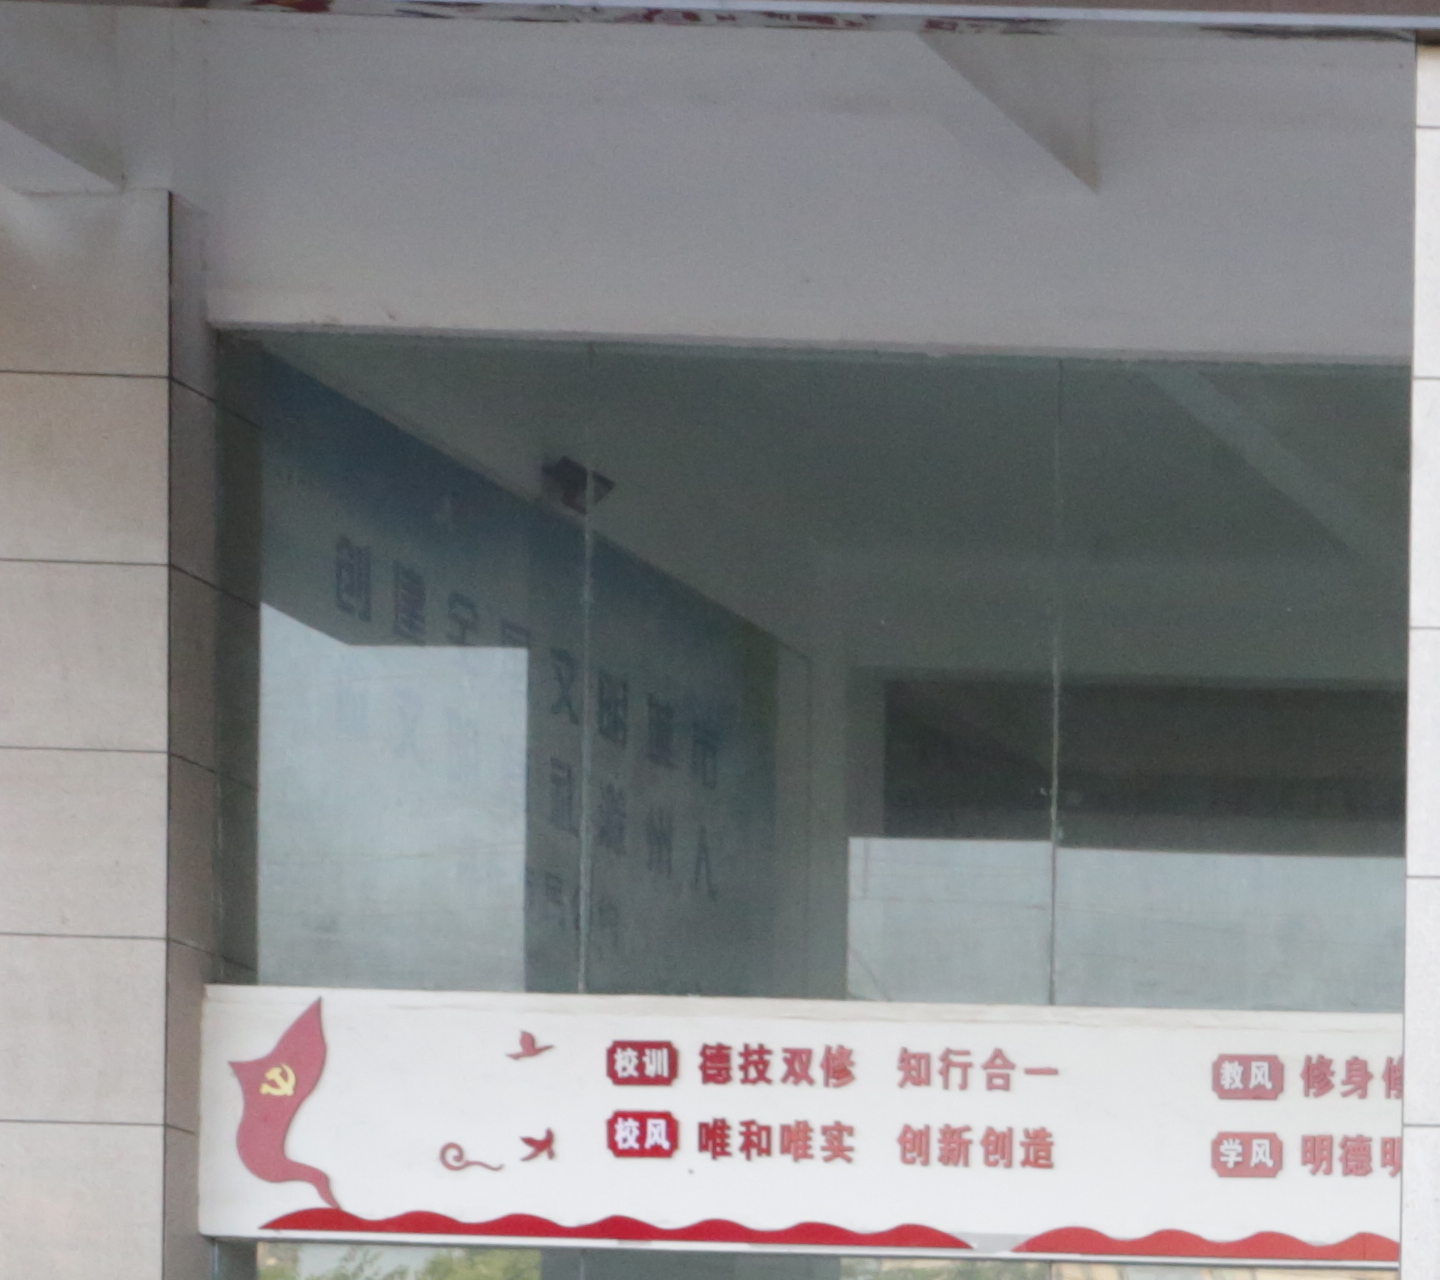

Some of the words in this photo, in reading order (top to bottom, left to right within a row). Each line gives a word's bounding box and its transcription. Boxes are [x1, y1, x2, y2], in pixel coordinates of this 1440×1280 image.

[613, 1047, 669, 1078] 校训
[698, 1043, 856, 1088] 德技双修
[897, 1047, 1058, 1091] 知行合一
[1221, 1061, 1273, 1090] 教风
[614, 1116, 671, 1151] 校风
[698, 1117, 855, 1162] 唯和唯实
[897, 1123, 1055, 1169] 创新创造
[1220, 1138, 1273, 1169] 学风
